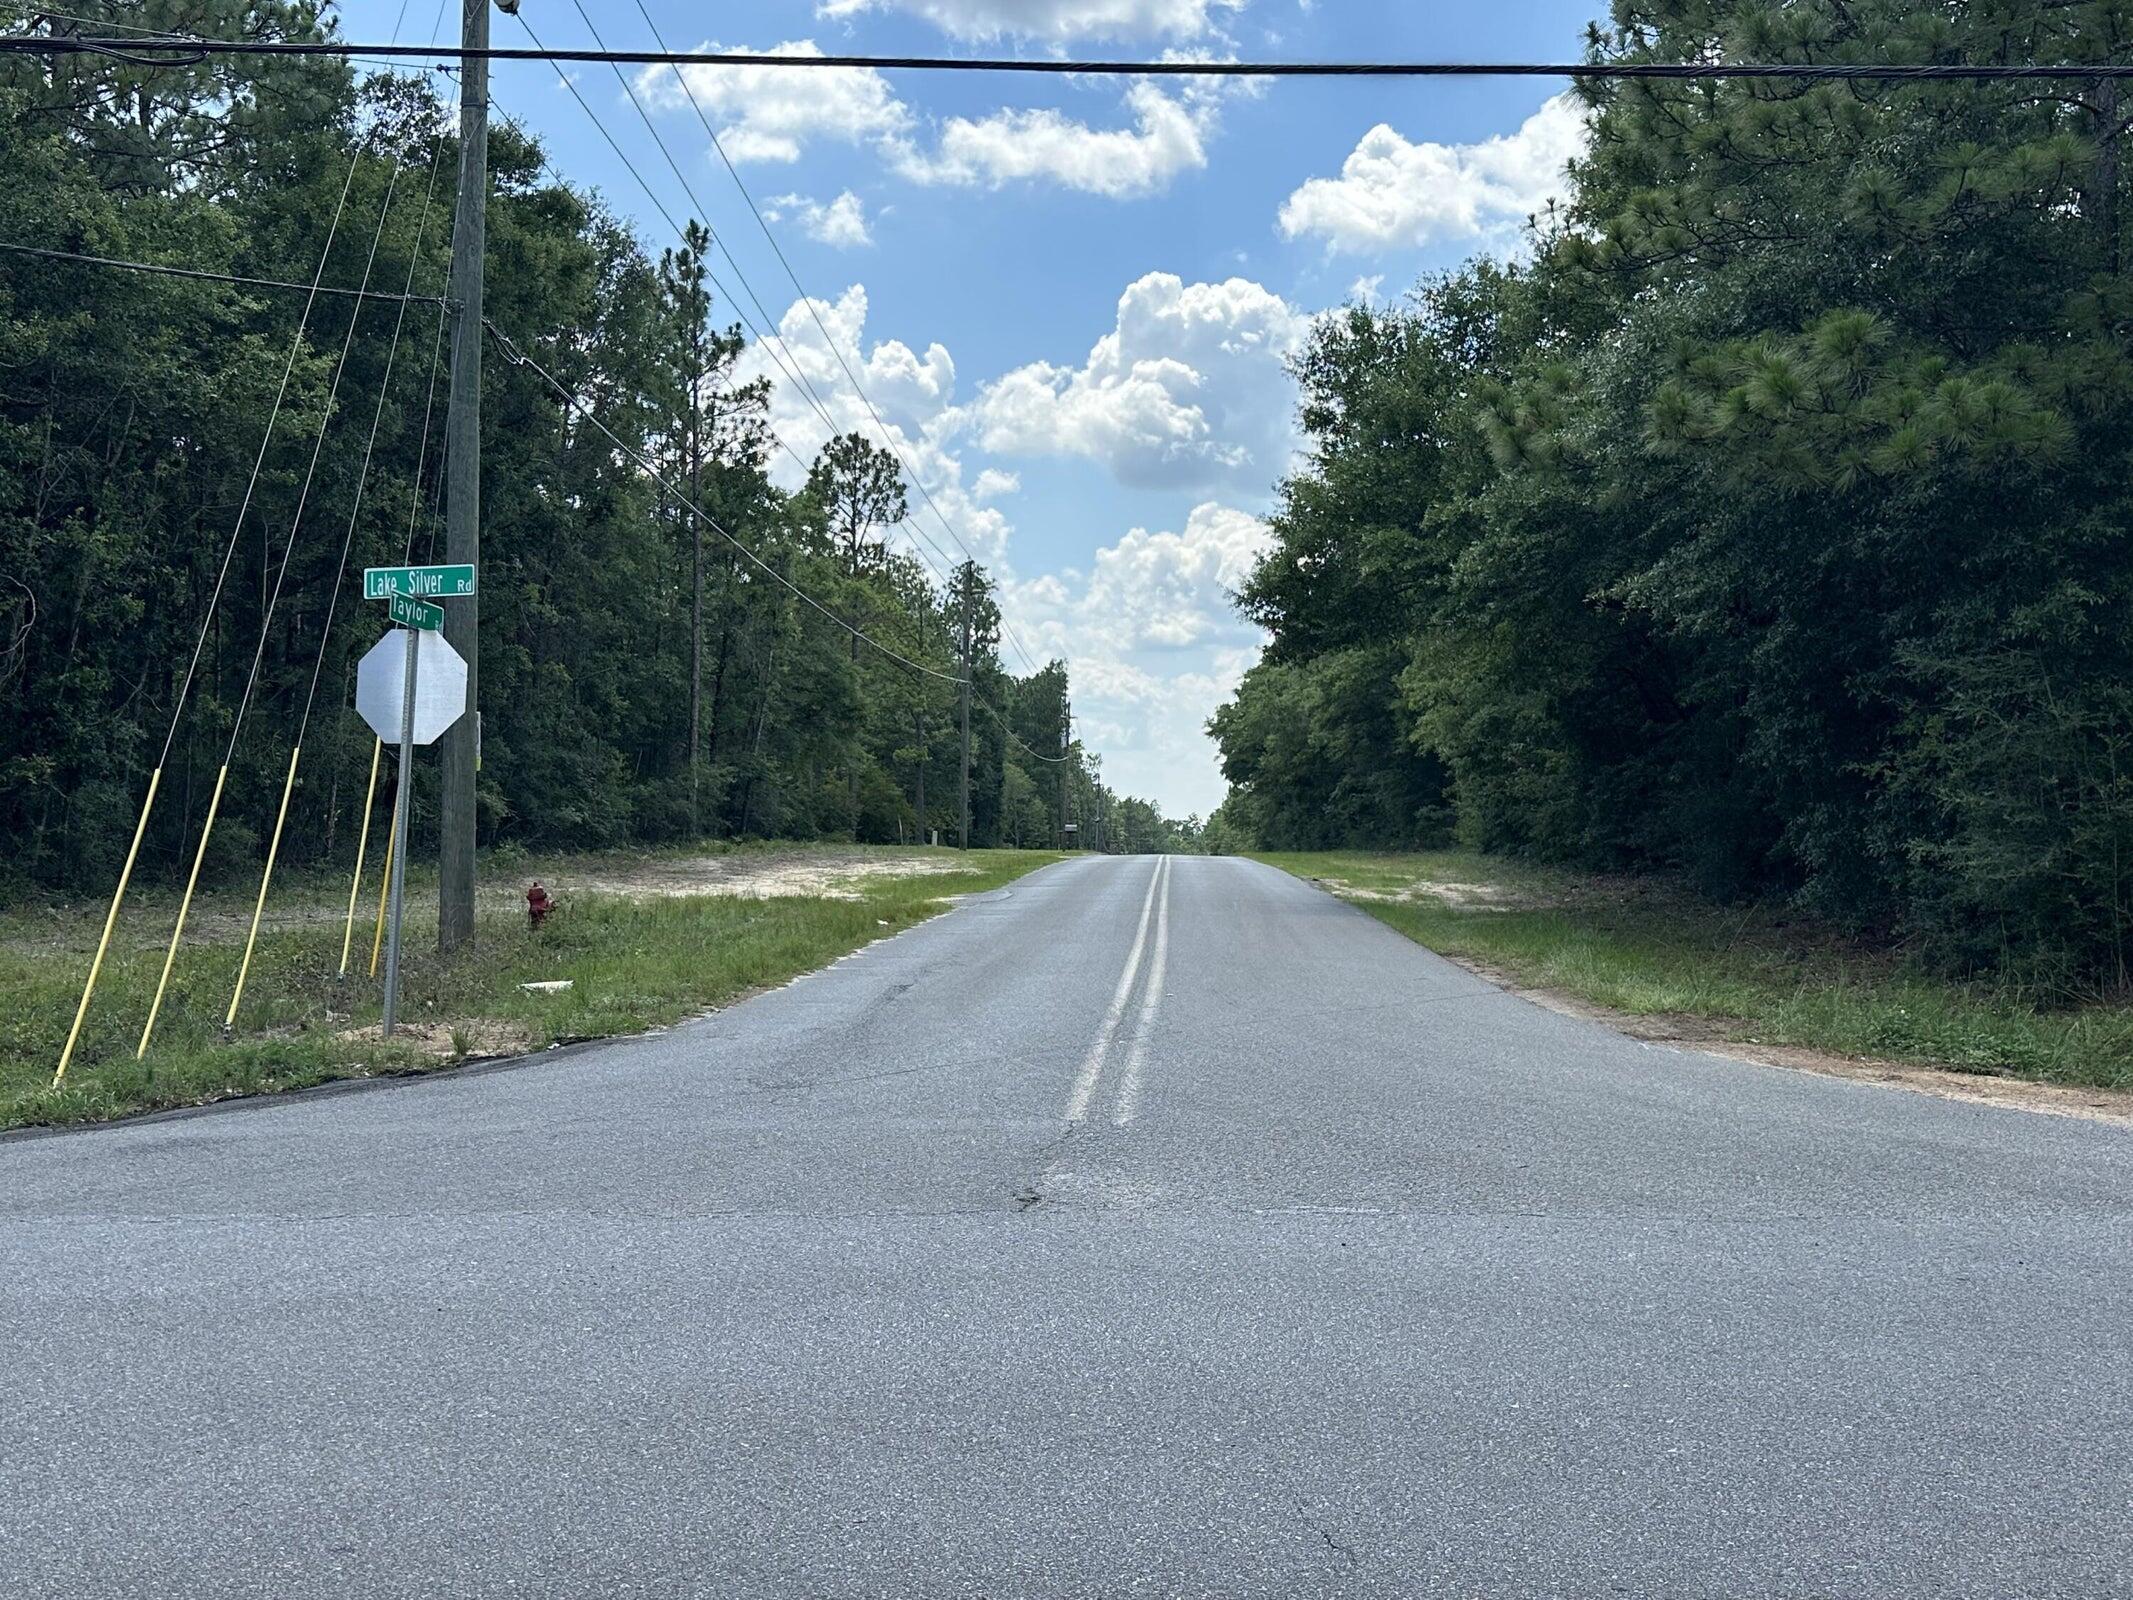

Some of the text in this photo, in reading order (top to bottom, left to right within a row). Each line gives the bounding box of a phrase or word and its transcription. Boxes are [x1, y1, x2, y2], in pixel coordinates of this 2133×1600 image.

[370, 570, 472, 596] Lake Silver Rd
[392, 593, 429, 623] Taylor
